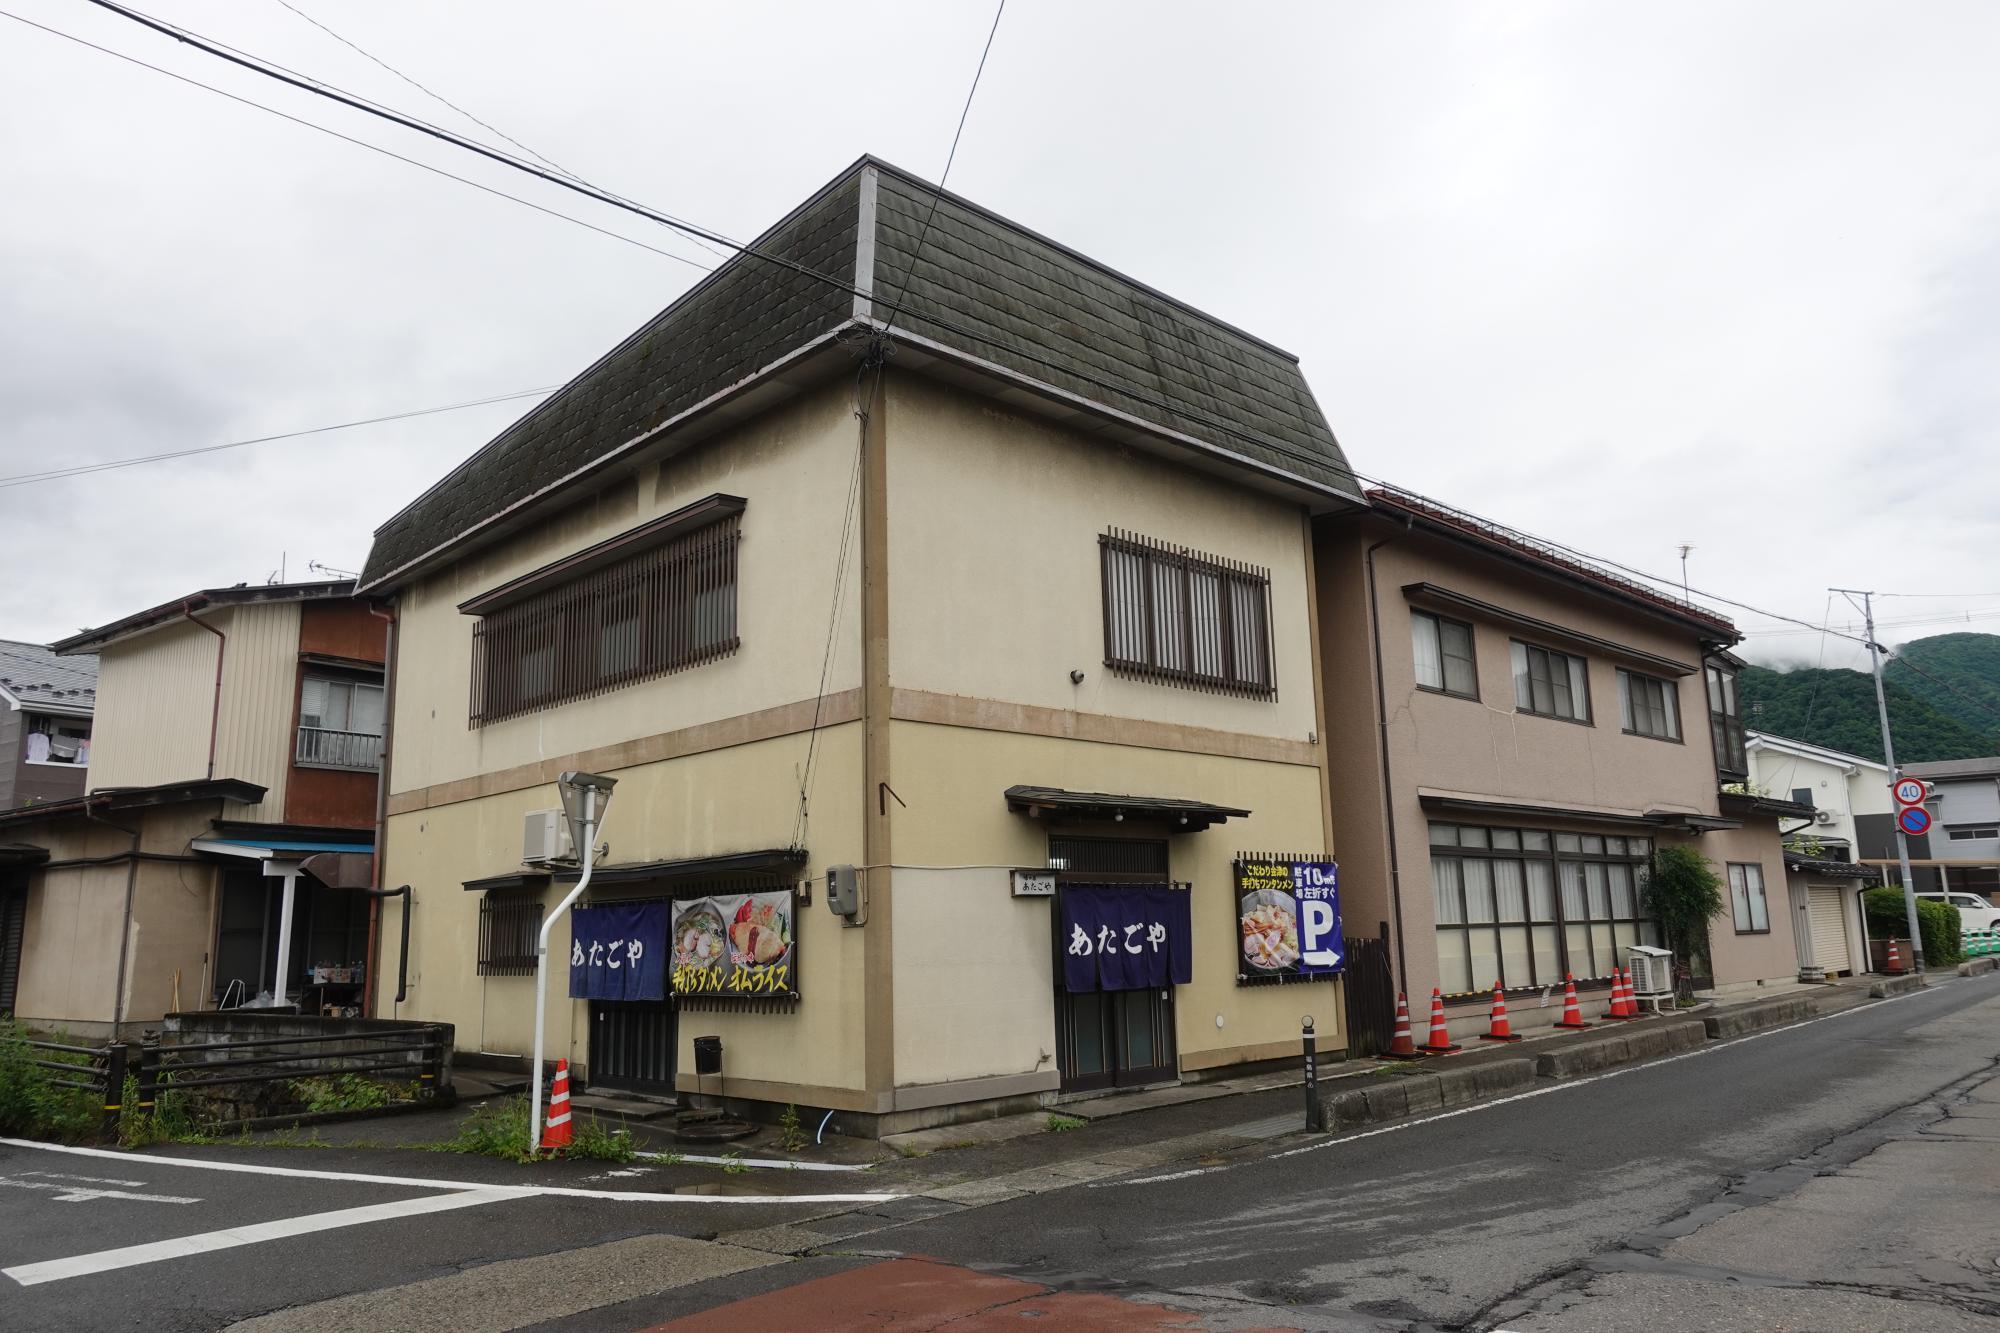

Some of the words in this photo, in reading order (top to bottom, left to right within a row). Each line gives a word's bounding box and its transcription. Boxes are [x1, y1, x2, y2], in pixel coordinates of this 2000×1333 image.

[1901, 785, 1919, 798] 40
[1022, 881, 1052, 892] あたごや
[1241, 877, 1294, 890] 手打ちワンタンメン
[1294, 866, 1303, 899] 駐車場
[1303, 886, 1336, 899] 左折すぐ
[1068, 922, 1167, 957] あたごや
[1302, 900, 1334, 951] P
[571, 938, 643, 969] あたごや
[727, 964, 789, 993] オムライス
